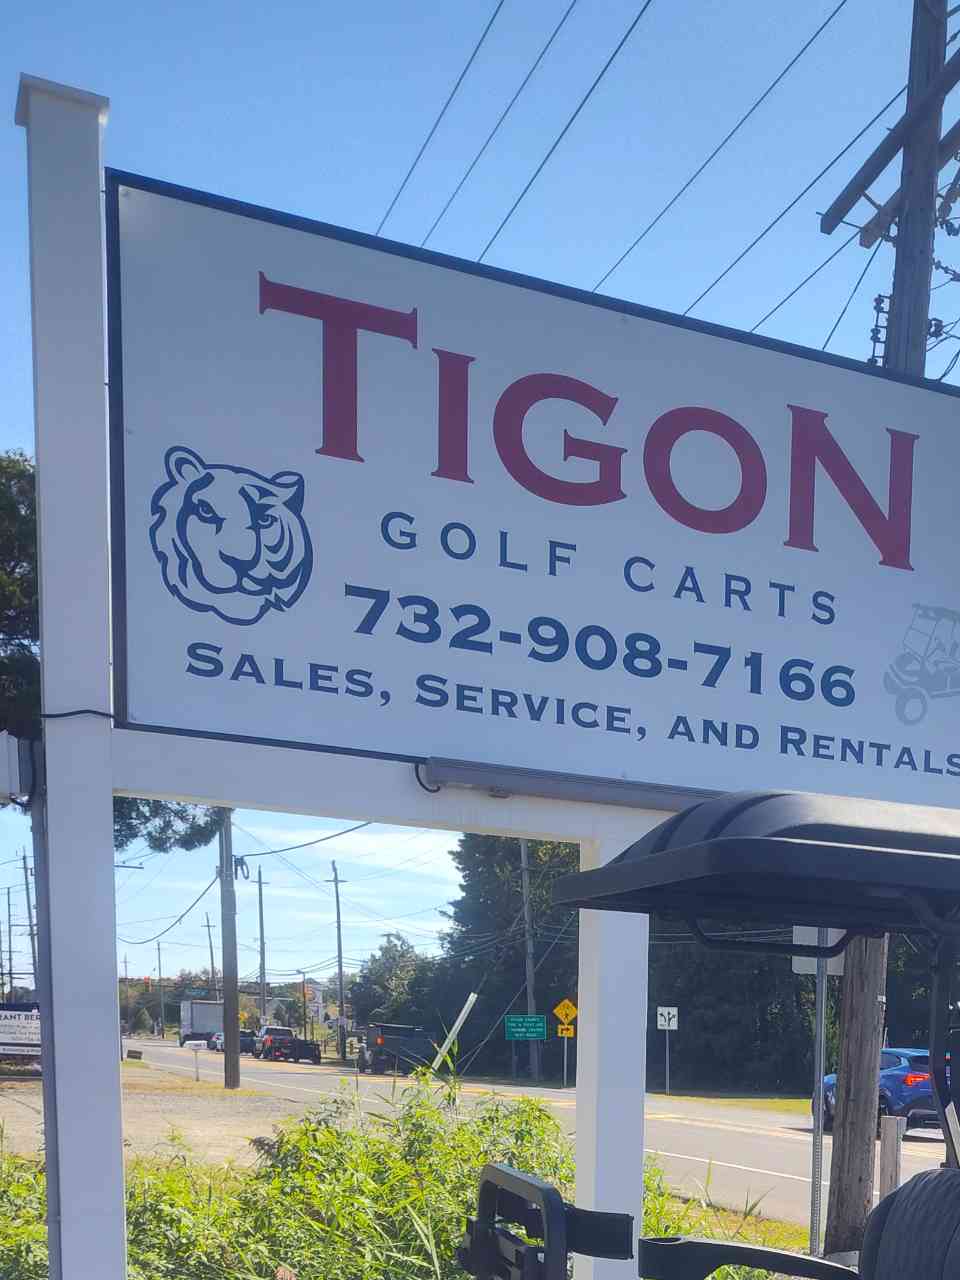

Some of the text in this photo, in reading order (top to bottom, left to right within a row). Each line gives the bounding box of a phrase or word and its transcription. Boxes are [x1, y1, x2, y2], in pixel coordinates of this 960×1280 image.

[258, 270, 920, 571] TIGON
[380, 510, 837, 626] GOLF CARTS
[184, 641, 392, 707] SALES,
[415, 673, 648, 742] SERVICE,
[667, 714, 760, 751] AND
[344, 583, 857, 708] 732-908-7166
